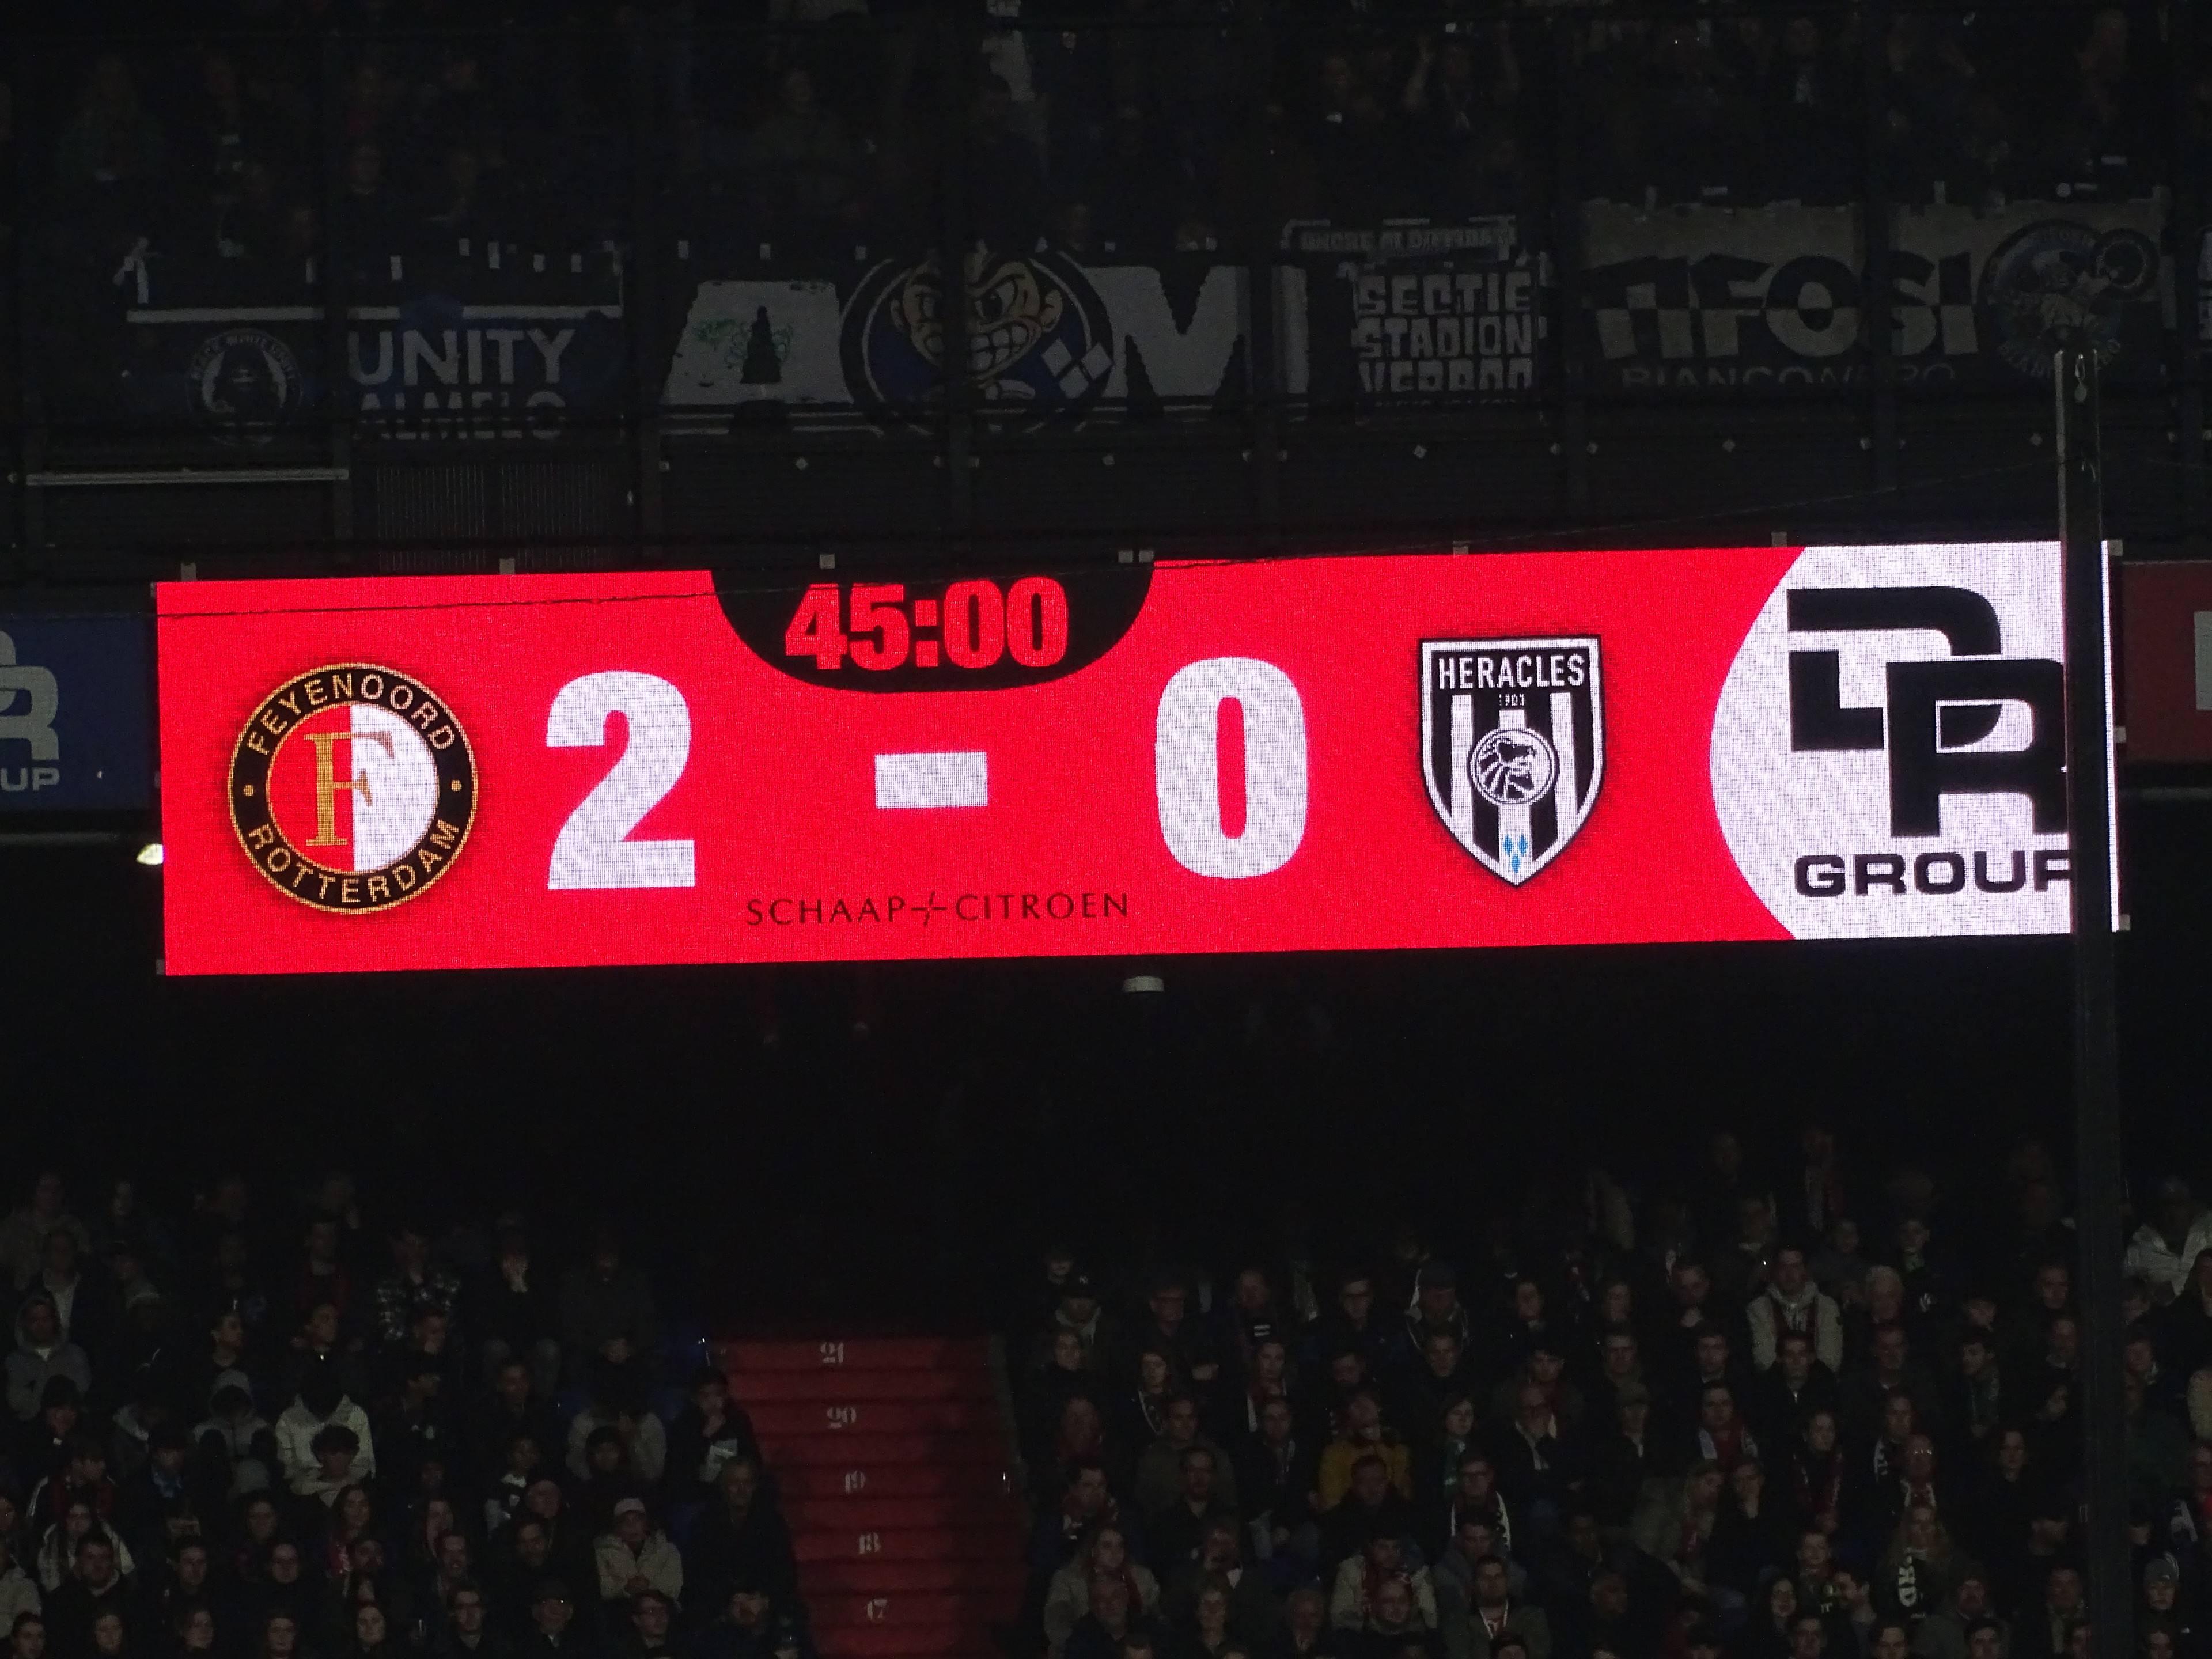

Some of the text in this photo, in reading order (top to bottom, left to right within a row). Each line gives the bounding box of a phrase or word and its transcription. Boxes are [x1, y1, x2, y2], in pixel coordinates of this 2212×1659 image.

[1356, 270, 1532, 315] SECTIE
[347, 329, 575, 385] UNITY
[1358, 315, 1533, 359] STADION
[785, 577, 1068, 670] 45:00
[1438, 653, 1585, 690] HERACLES
[247, 672, 455, 756] FEYENOORD
[1499, 694, 1525, 706] 1903
[304, 730, 395, 847] F
[546, 670, 695, 890] 2
[1155, 657, 1308, 879] 0
[249, 819, 460, 904] ROTTERDAM
[749, 892, 1128, 925] SCHAAP CITROEN
